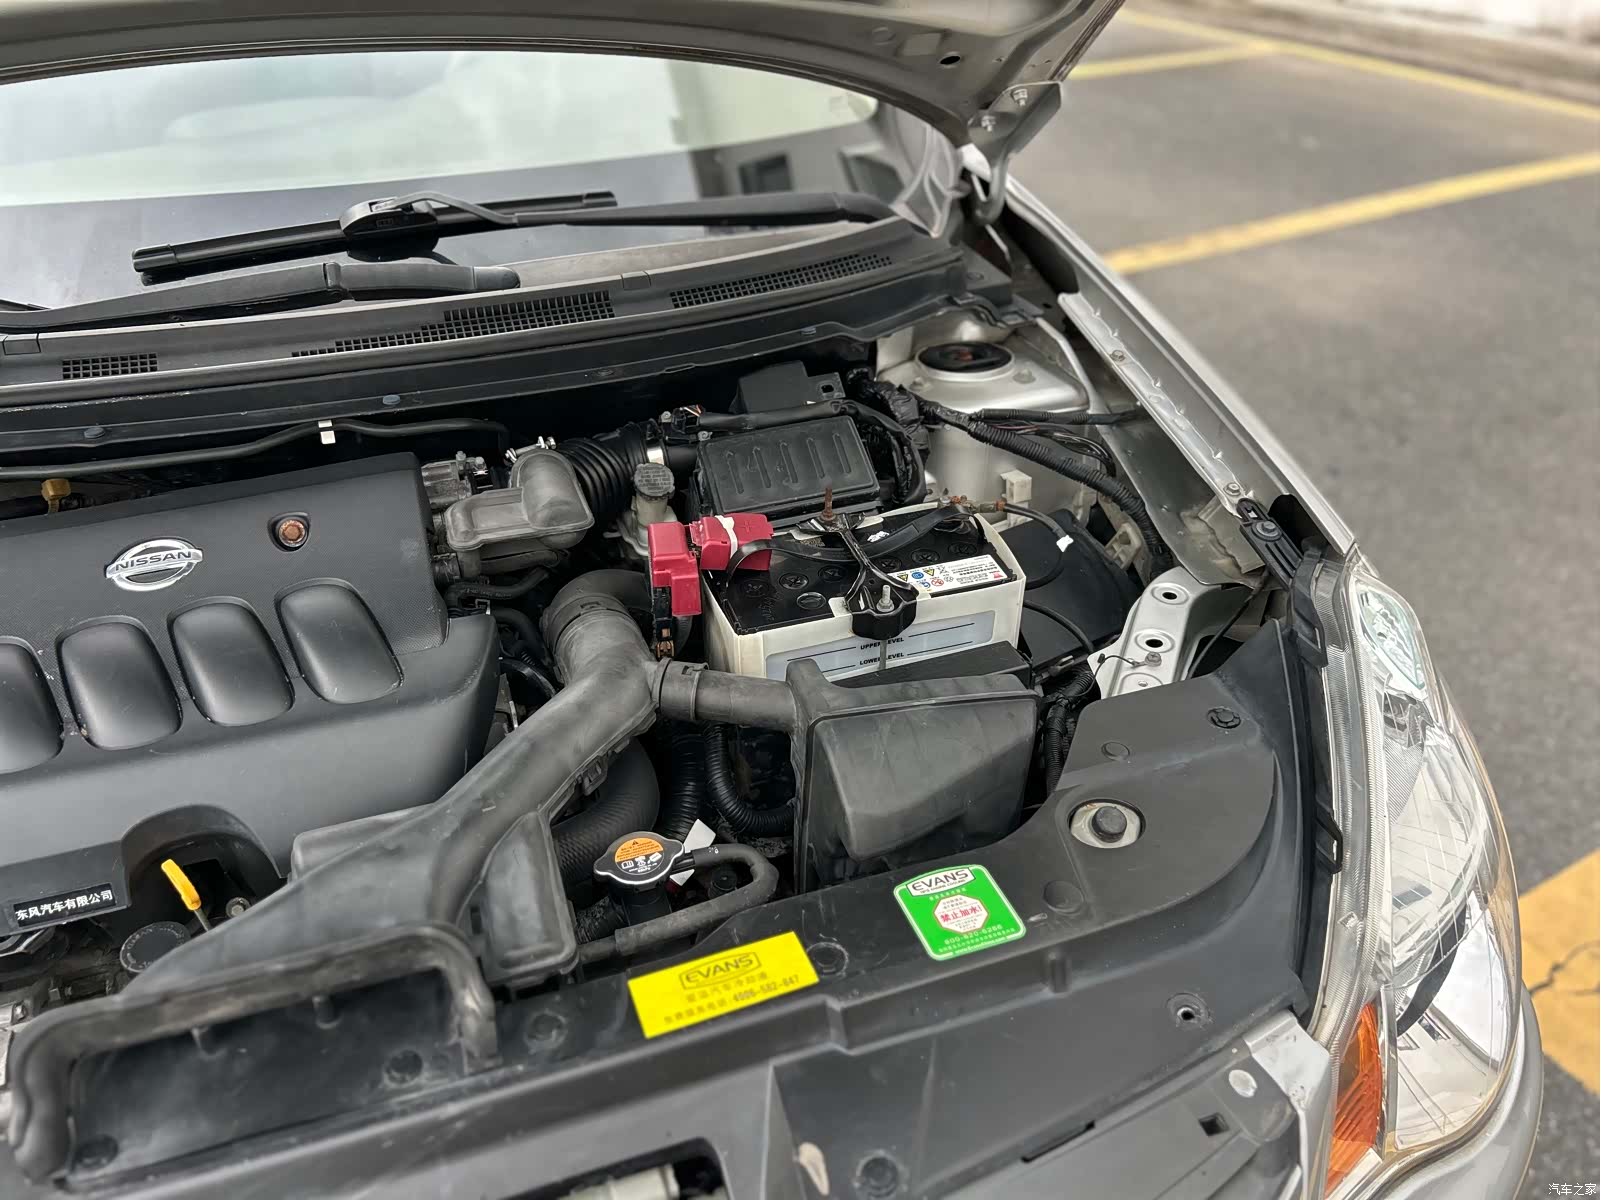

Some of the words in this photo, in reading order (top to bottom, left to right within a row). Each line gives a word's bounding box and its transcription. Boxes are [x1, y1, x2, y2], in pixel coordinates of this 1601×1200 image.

[115, 551, 192, 571] NISSAN
[886, 637, 905, 645] EVEL
[886, 652, 905, 660] EVEL
[911, 869, 969, 892] EVANS
[15, 889, 114, 921] 东风汽车有限公司
[685, 953, 754, 984] EVANS
